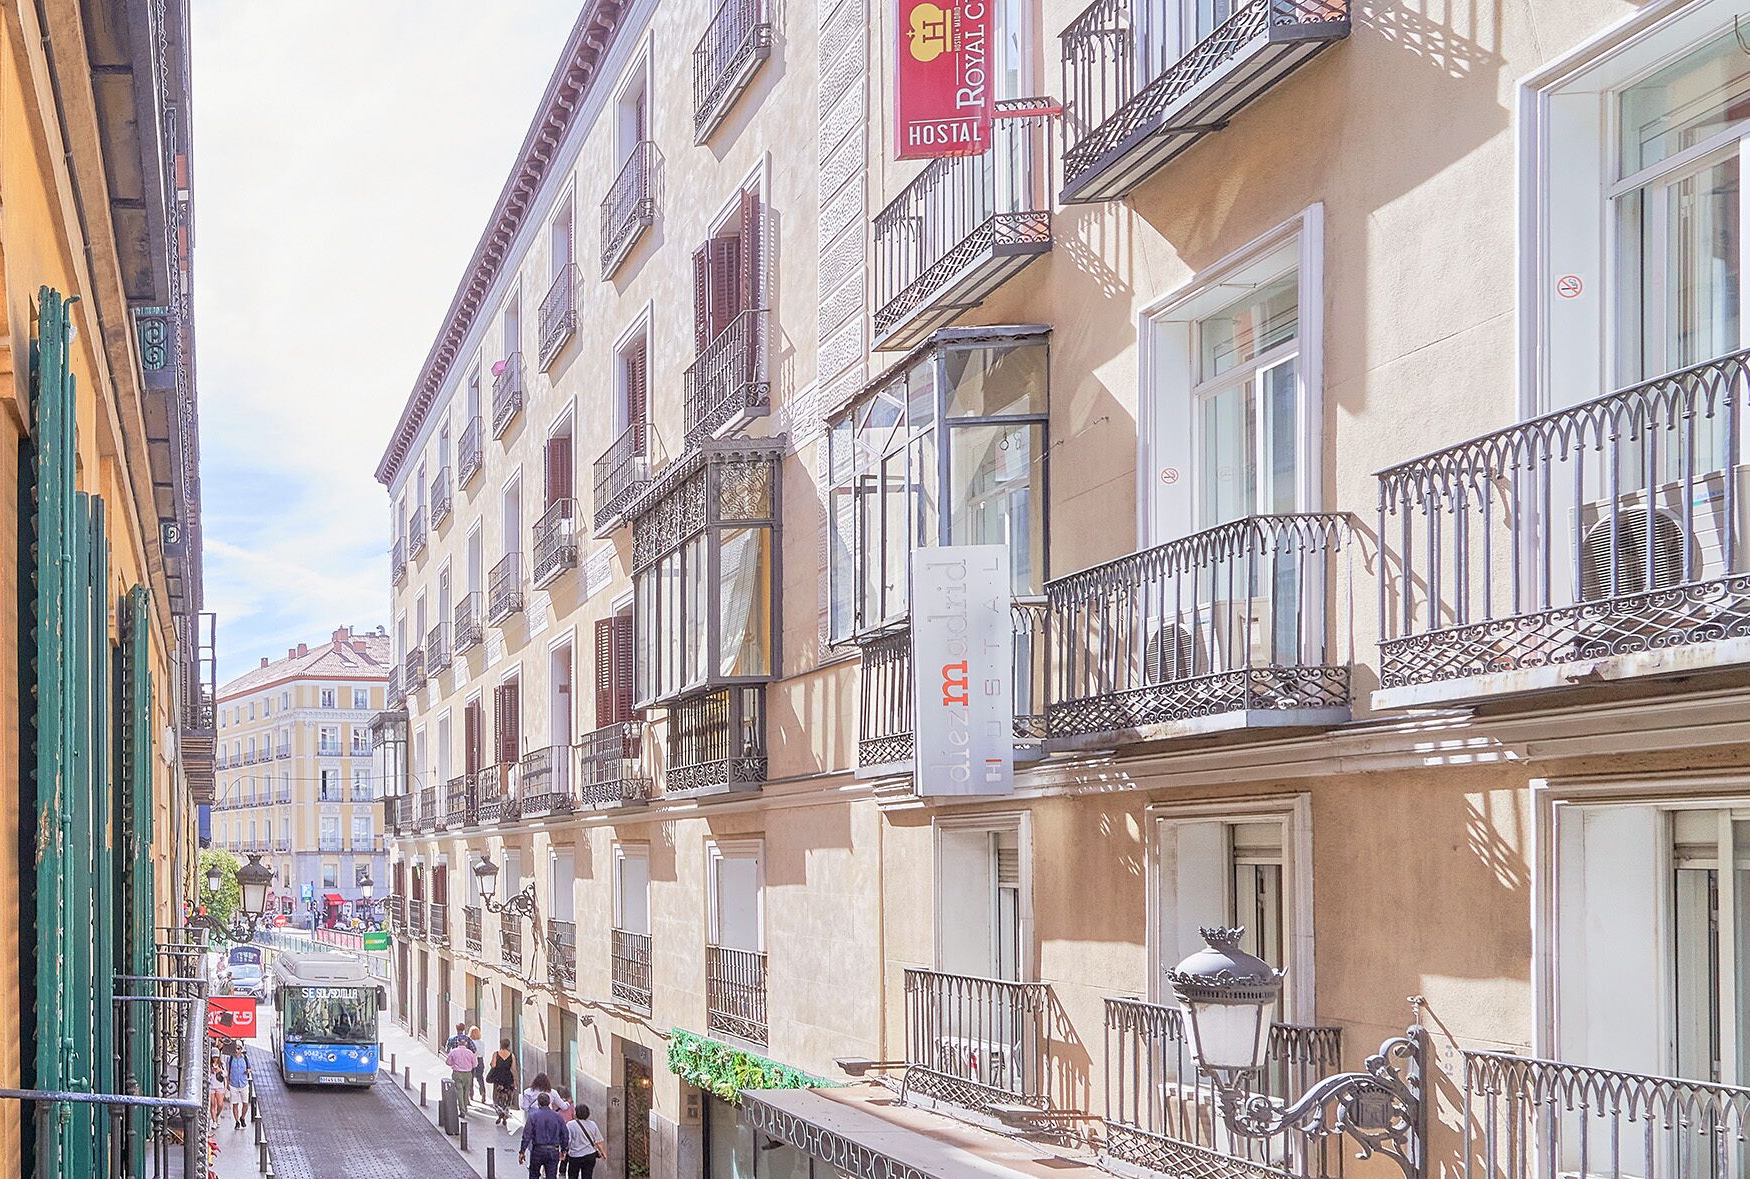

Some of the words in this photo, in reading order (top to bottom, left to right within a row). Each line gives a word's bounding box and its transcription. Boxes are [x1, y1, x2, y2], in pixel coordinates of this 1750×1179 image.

[956, 24, 985, 110] ROYAL
[909, 121, 982, 146] HOSTAL
[742, 1099, 807, 1150] TORERO
